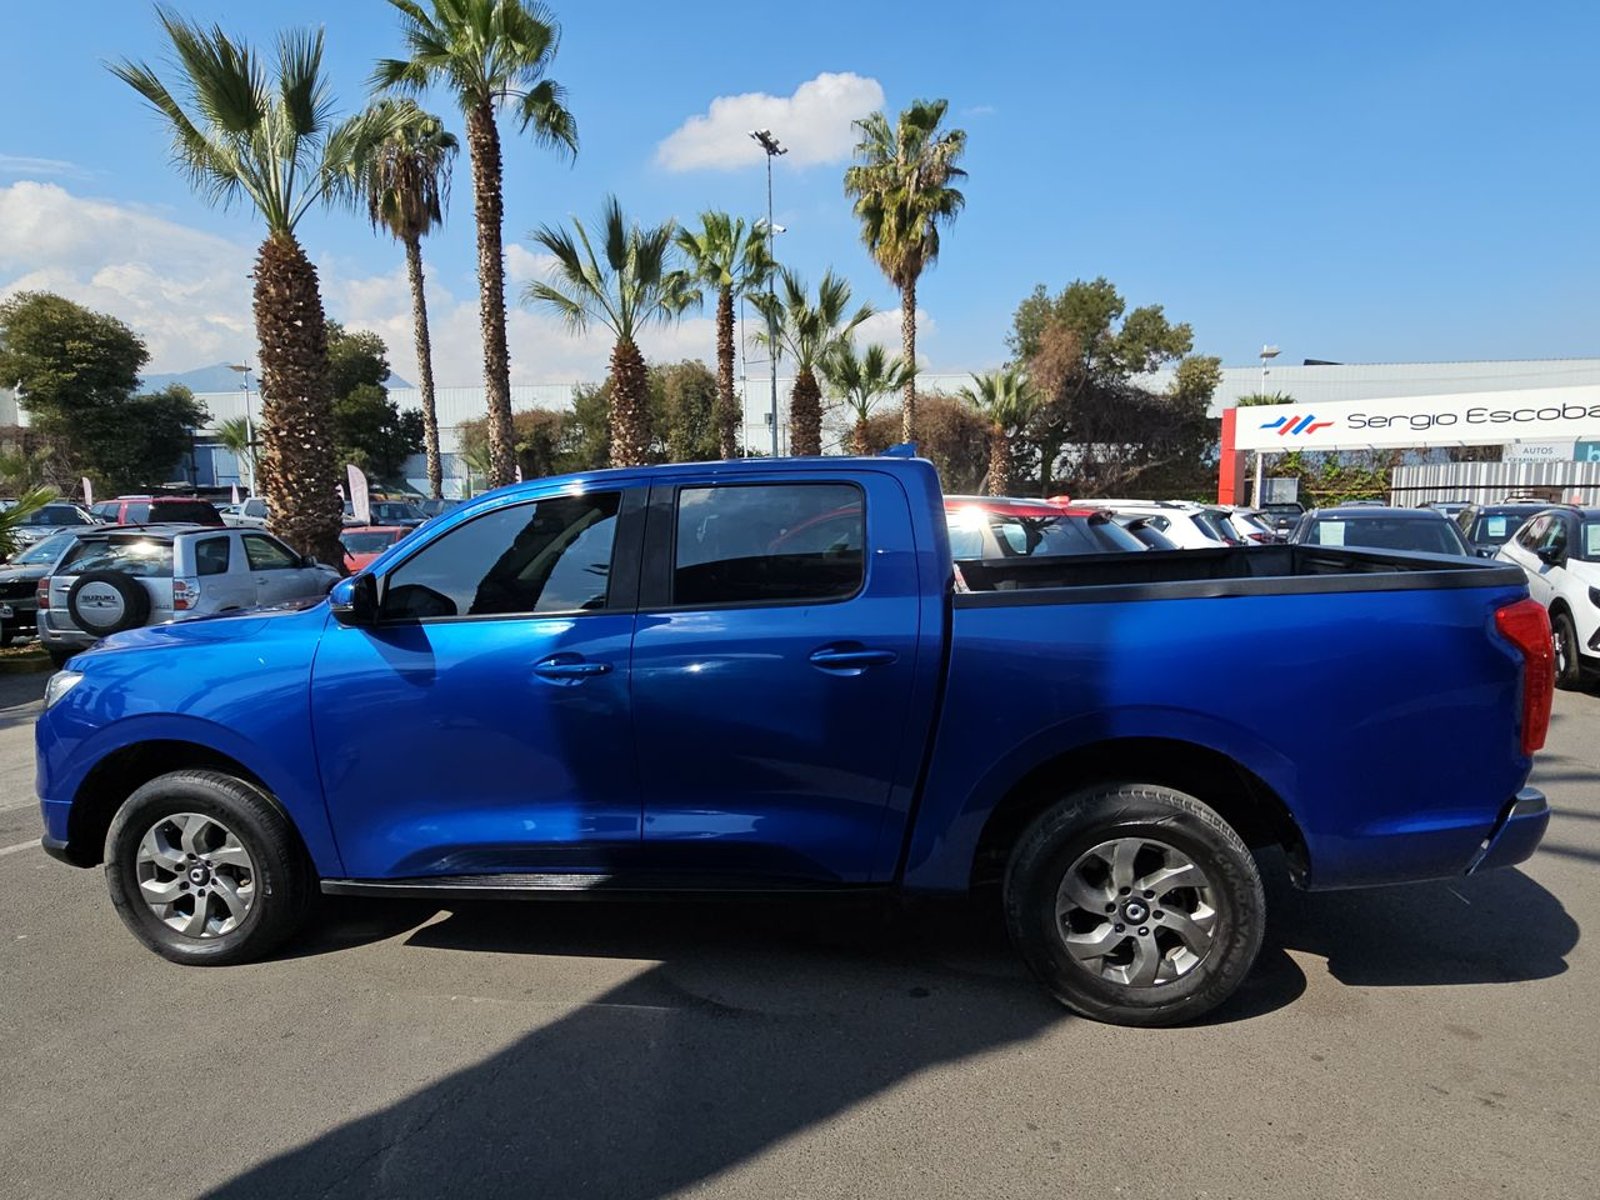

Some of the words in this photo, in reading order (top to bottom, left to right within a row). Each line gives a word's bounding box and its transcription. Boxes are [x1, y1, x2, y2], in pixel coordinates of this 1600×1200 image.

[1347, 413, 1458, 430] Sergio
[1466, 403, 1600, 423] Escoba
[1522, 447, 1554, 455] AUTOS
